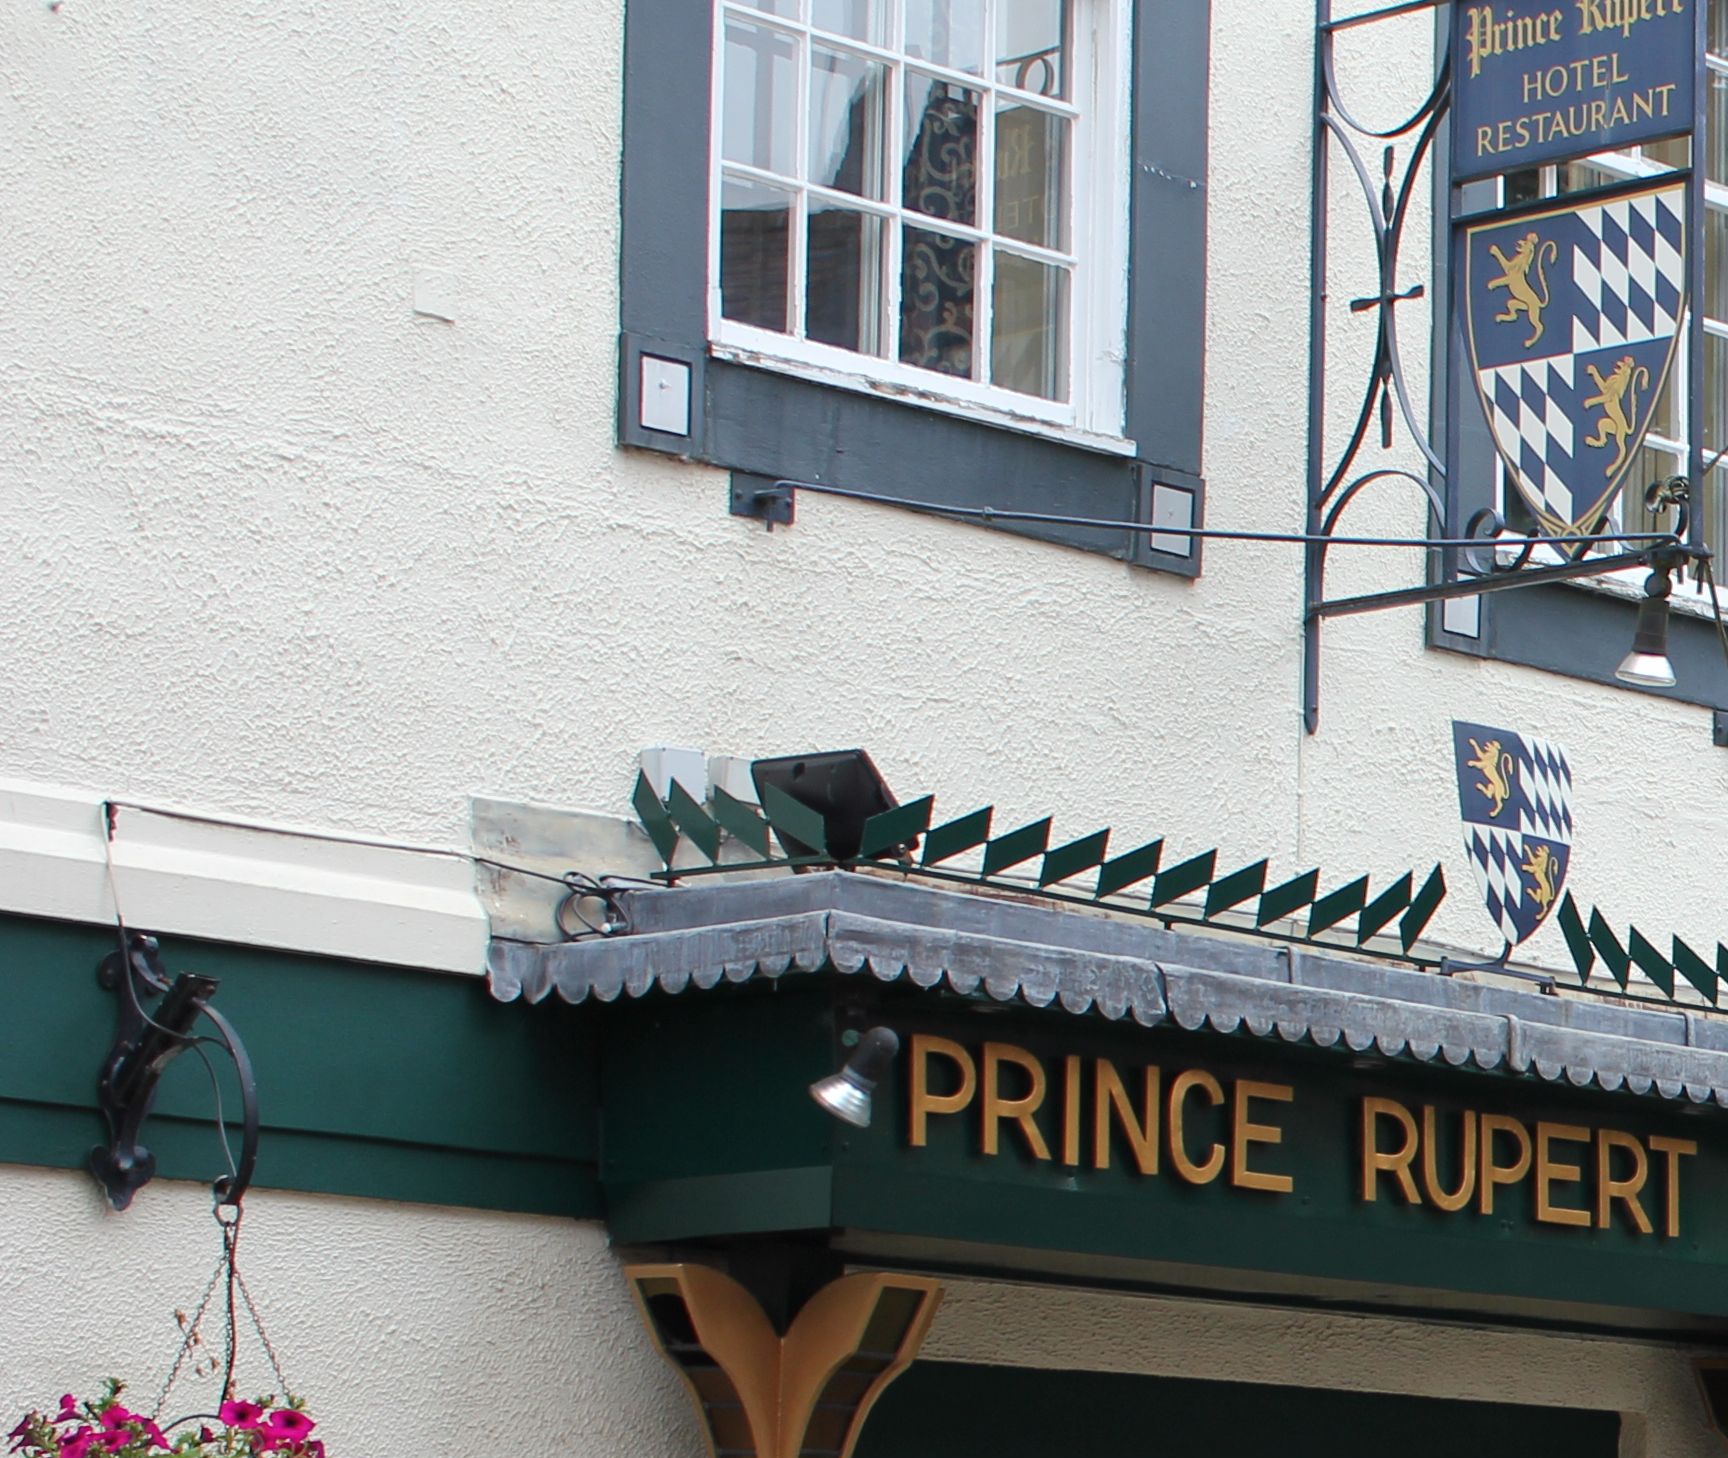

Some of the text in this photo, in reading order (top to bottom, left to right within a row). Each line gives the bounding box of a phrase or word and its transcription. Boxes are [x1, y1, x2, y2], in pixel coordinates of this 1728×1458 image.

[1466, 6, 1563, 78] Prince
[1522, 53, 1630, 103] HOTEL
[1476, 84, 1677, 157] RESTAURANT
[909, 1034, 1294, 1193] PRINCE
[1362, 1096, 1698, 1238] RUPERT
